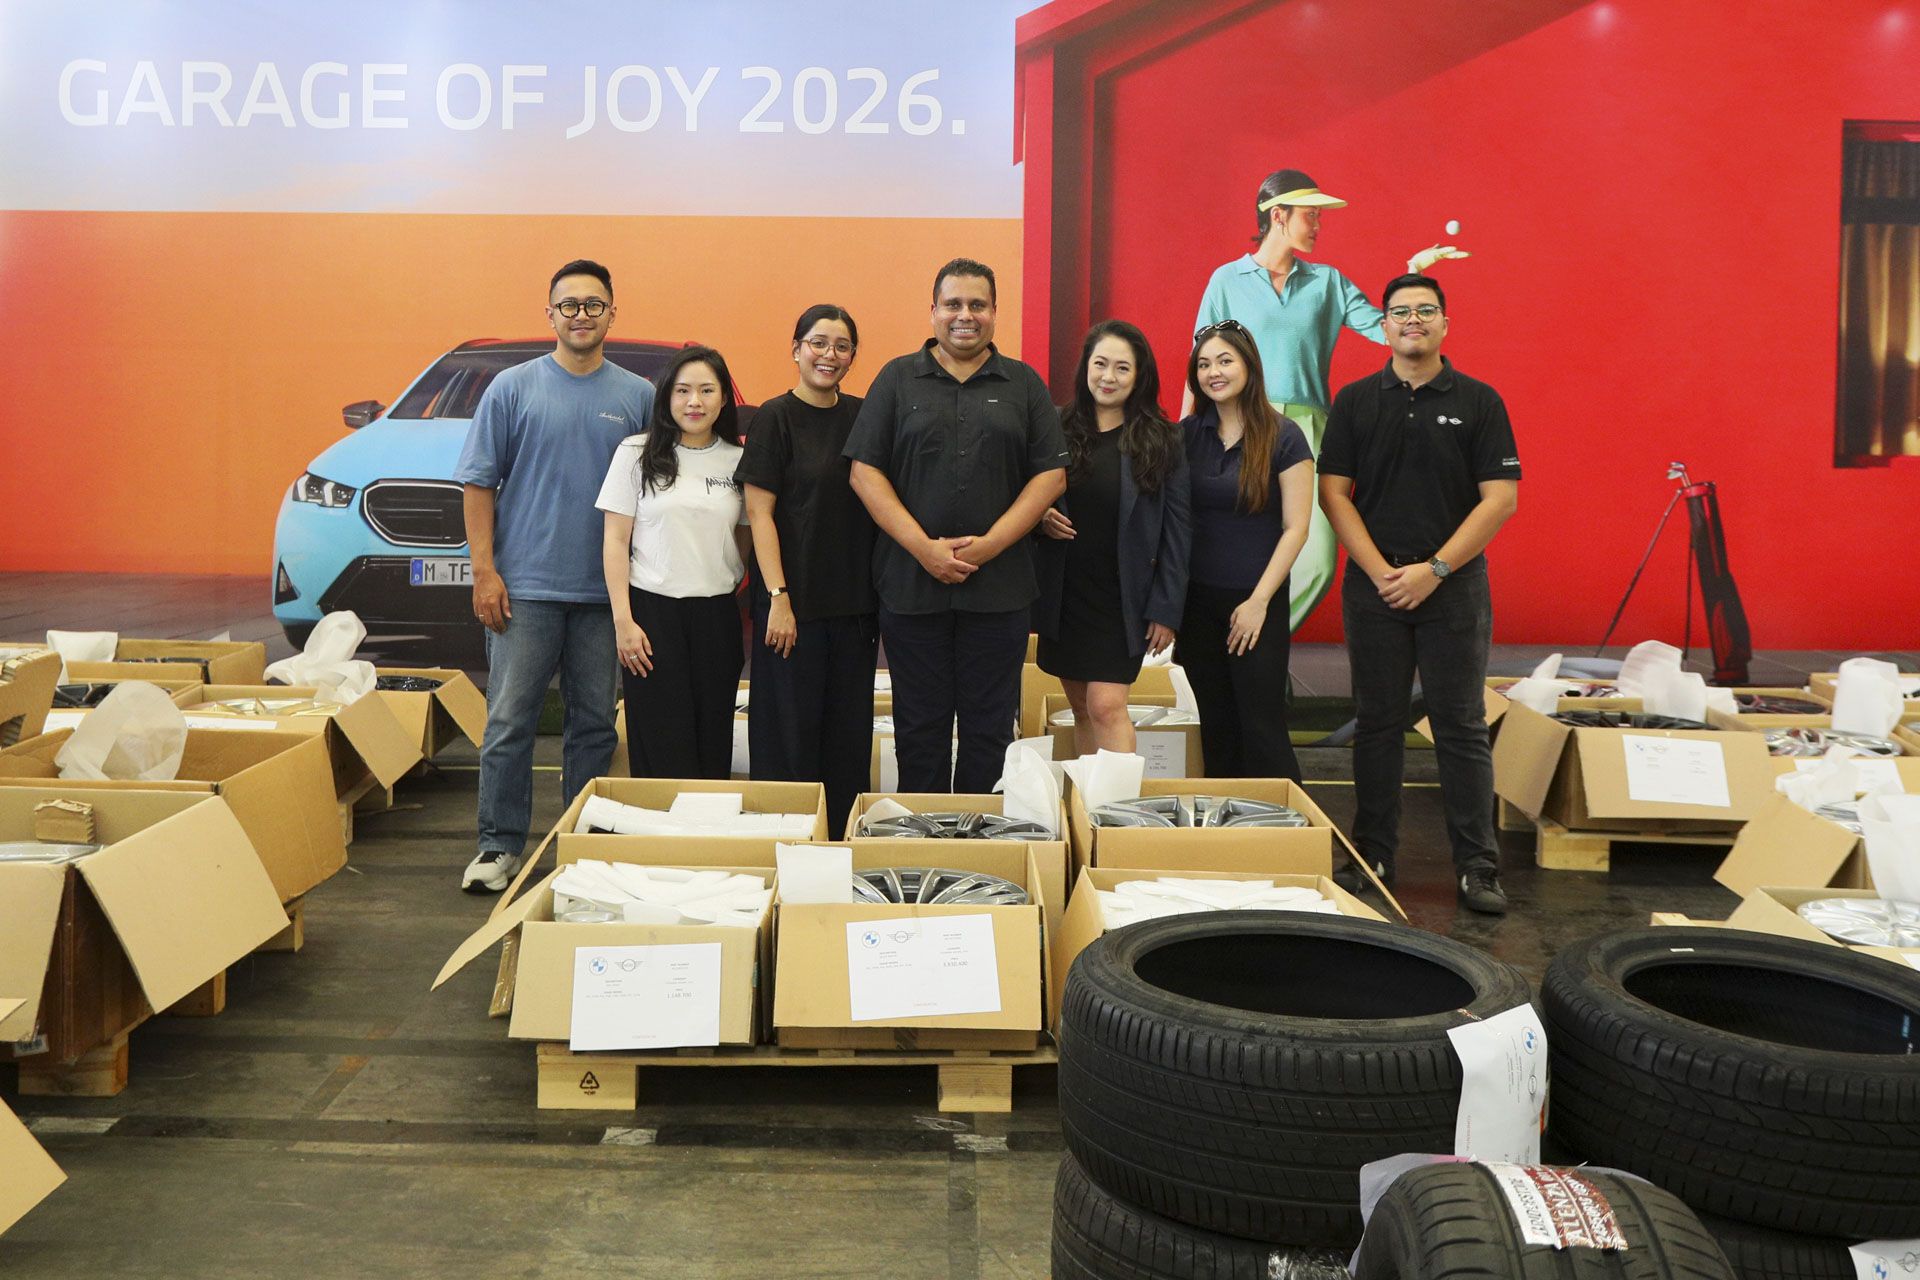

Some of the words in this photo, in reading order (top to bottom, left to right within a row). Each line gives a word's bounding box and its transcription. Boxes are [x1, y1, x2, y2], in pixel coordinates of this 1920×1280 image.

[58, 58, 409, 129] GARAGE
[435, 63, 548, 131] OF
[566, 64, 720, 139] JOY
[739, 66, 965, 136] 2026.
[425, 563, 435, 581] M
[448, 563, 471, 581] TF
